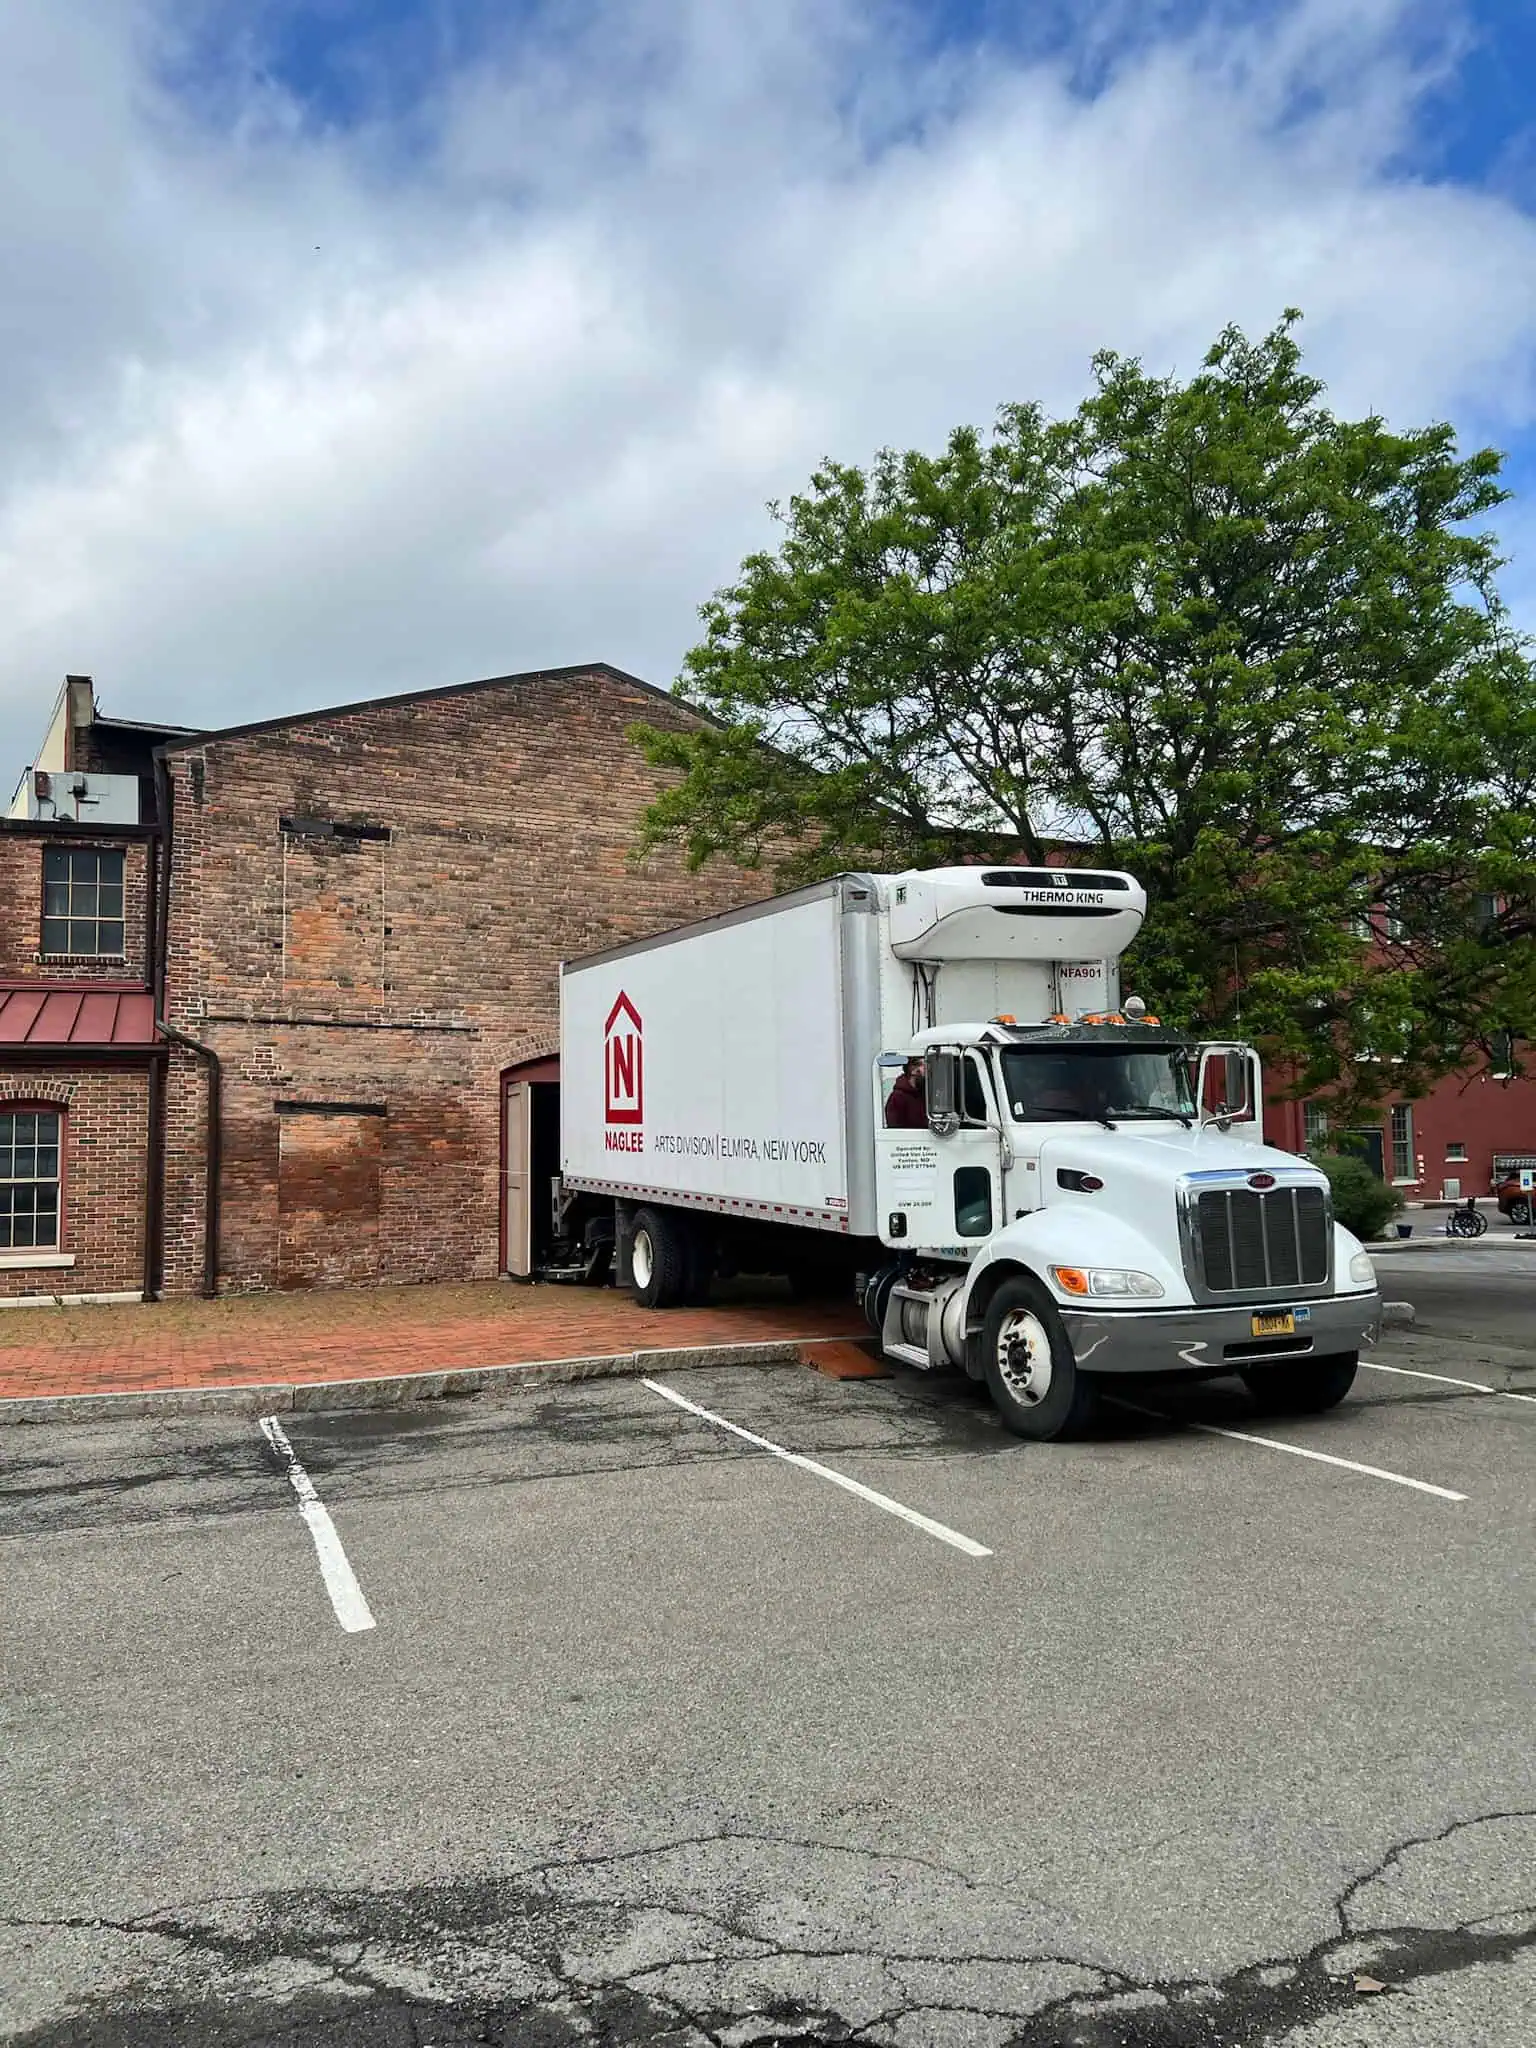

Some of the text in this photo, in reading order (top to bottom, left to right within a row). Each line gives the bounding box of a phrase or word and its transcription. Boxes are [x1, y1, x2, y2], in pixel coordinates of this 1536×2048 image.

[1023, 890, 1104, 904] THERMO KING
[1060, 967, 1102, 978] NFA901
[613, 1033, 634, 1099] N
[605, 1131, 643, 1152] NAGLEE
[655, 1135, 675, 1153] ARTS
[677, 1136, 714, 1156] DIVISION
[763, 1138, 789, 1161] NEW
[791, 1140, 826, 1164] YORK
